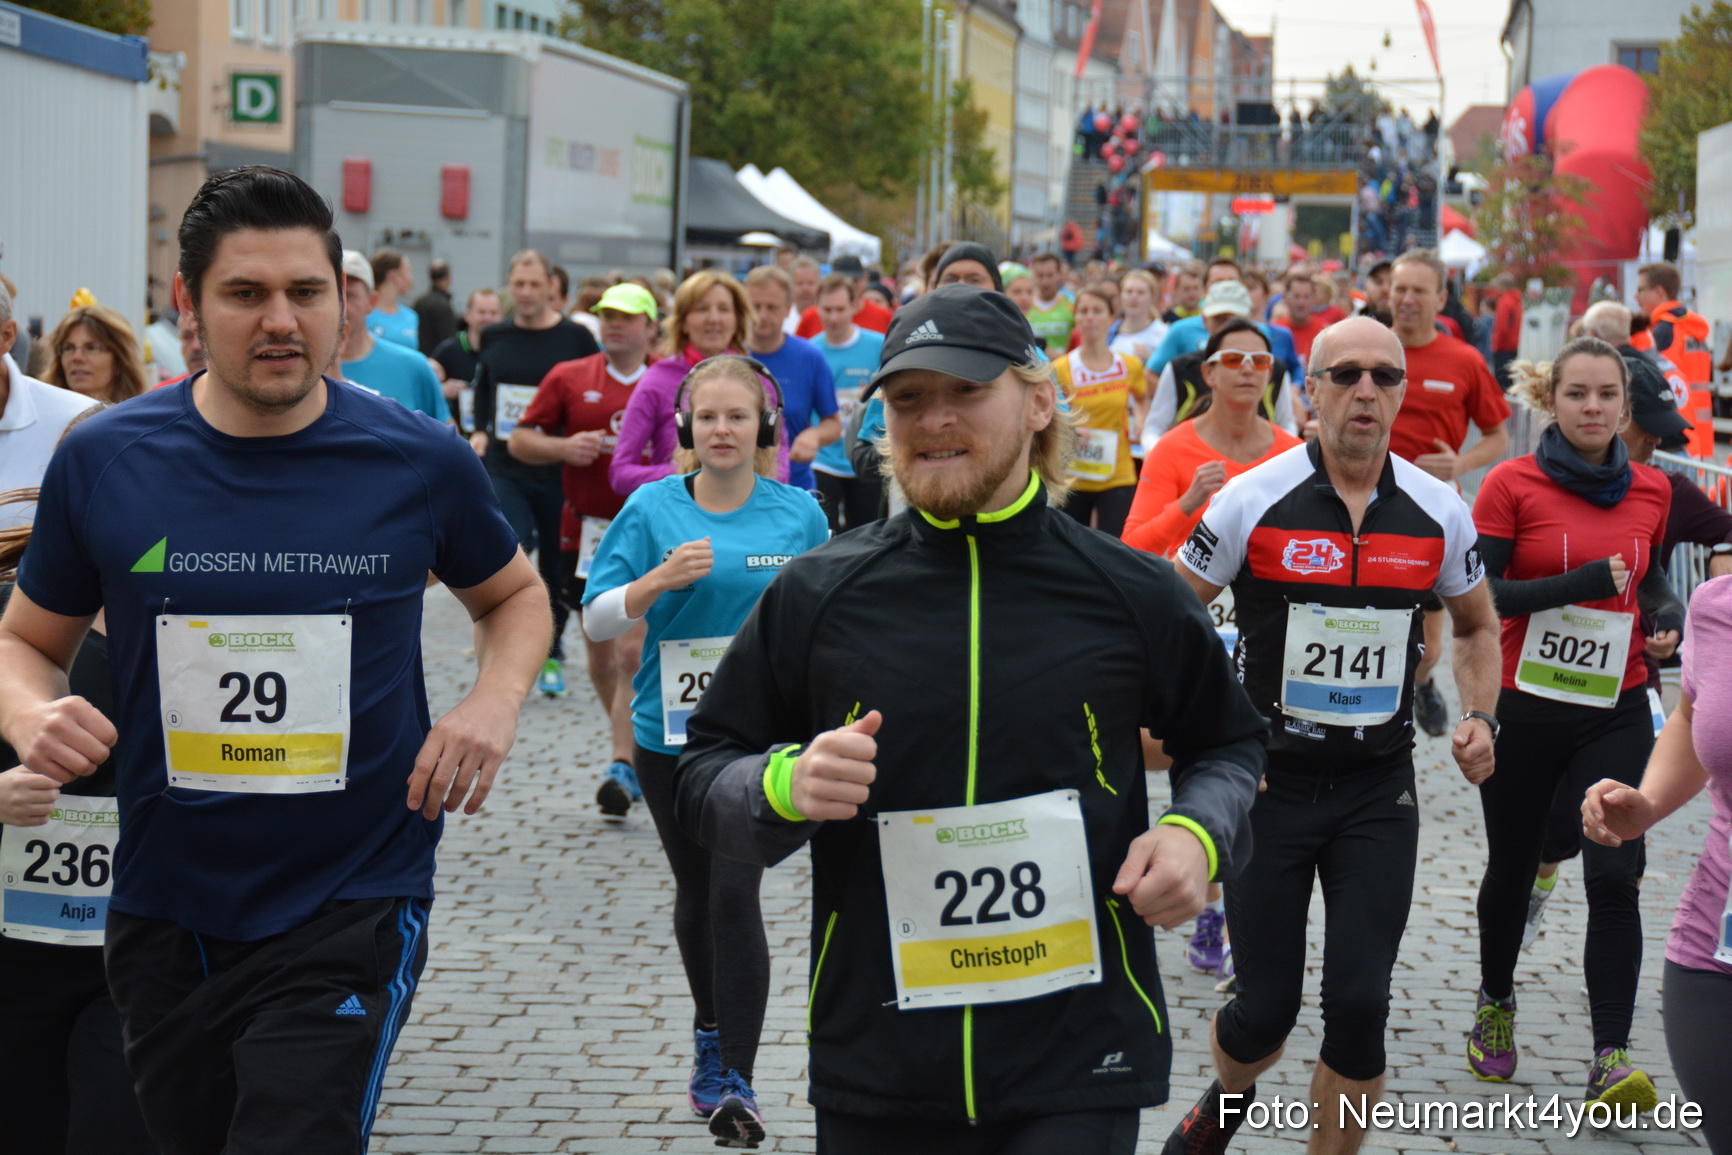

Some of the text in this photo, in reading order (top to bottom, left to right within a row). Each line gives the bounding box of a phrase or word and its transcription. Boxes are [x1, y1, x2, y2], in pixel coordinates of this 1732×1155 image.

[238, 79, 275, 118] D
[905, 333, 944, 345] adidas
[168, 552, 391, 575] GOSSEN METRAWATT
[1377, 556, 1407, 564] STUNDEN
[1407, 559, 1430, 567] RENNEN
[1337, 619, 1380, 631] BOCK
[228, 632, 295, 647] BOCK
[1539, 630, 1611, 669] 5021
[1303, 642, 1387, 680] 2141
[1552, 672, 1588, 687] Melina
[219, 671, 288, 724] 29
[1328, 691, 1362, 705] Klaus
[221, 743, 286, 762] Roman
[956, 817, 1028, 842] BOCK
[23, 839, 119, 888] 236
[934, 861, 1046, 926] 228
[60, 902, 96, 922] Anja
[902, 923, 910, 934] D
[951, 940, 1048, 969] Christoph
[335, 1007, 367, 1015] adidas
